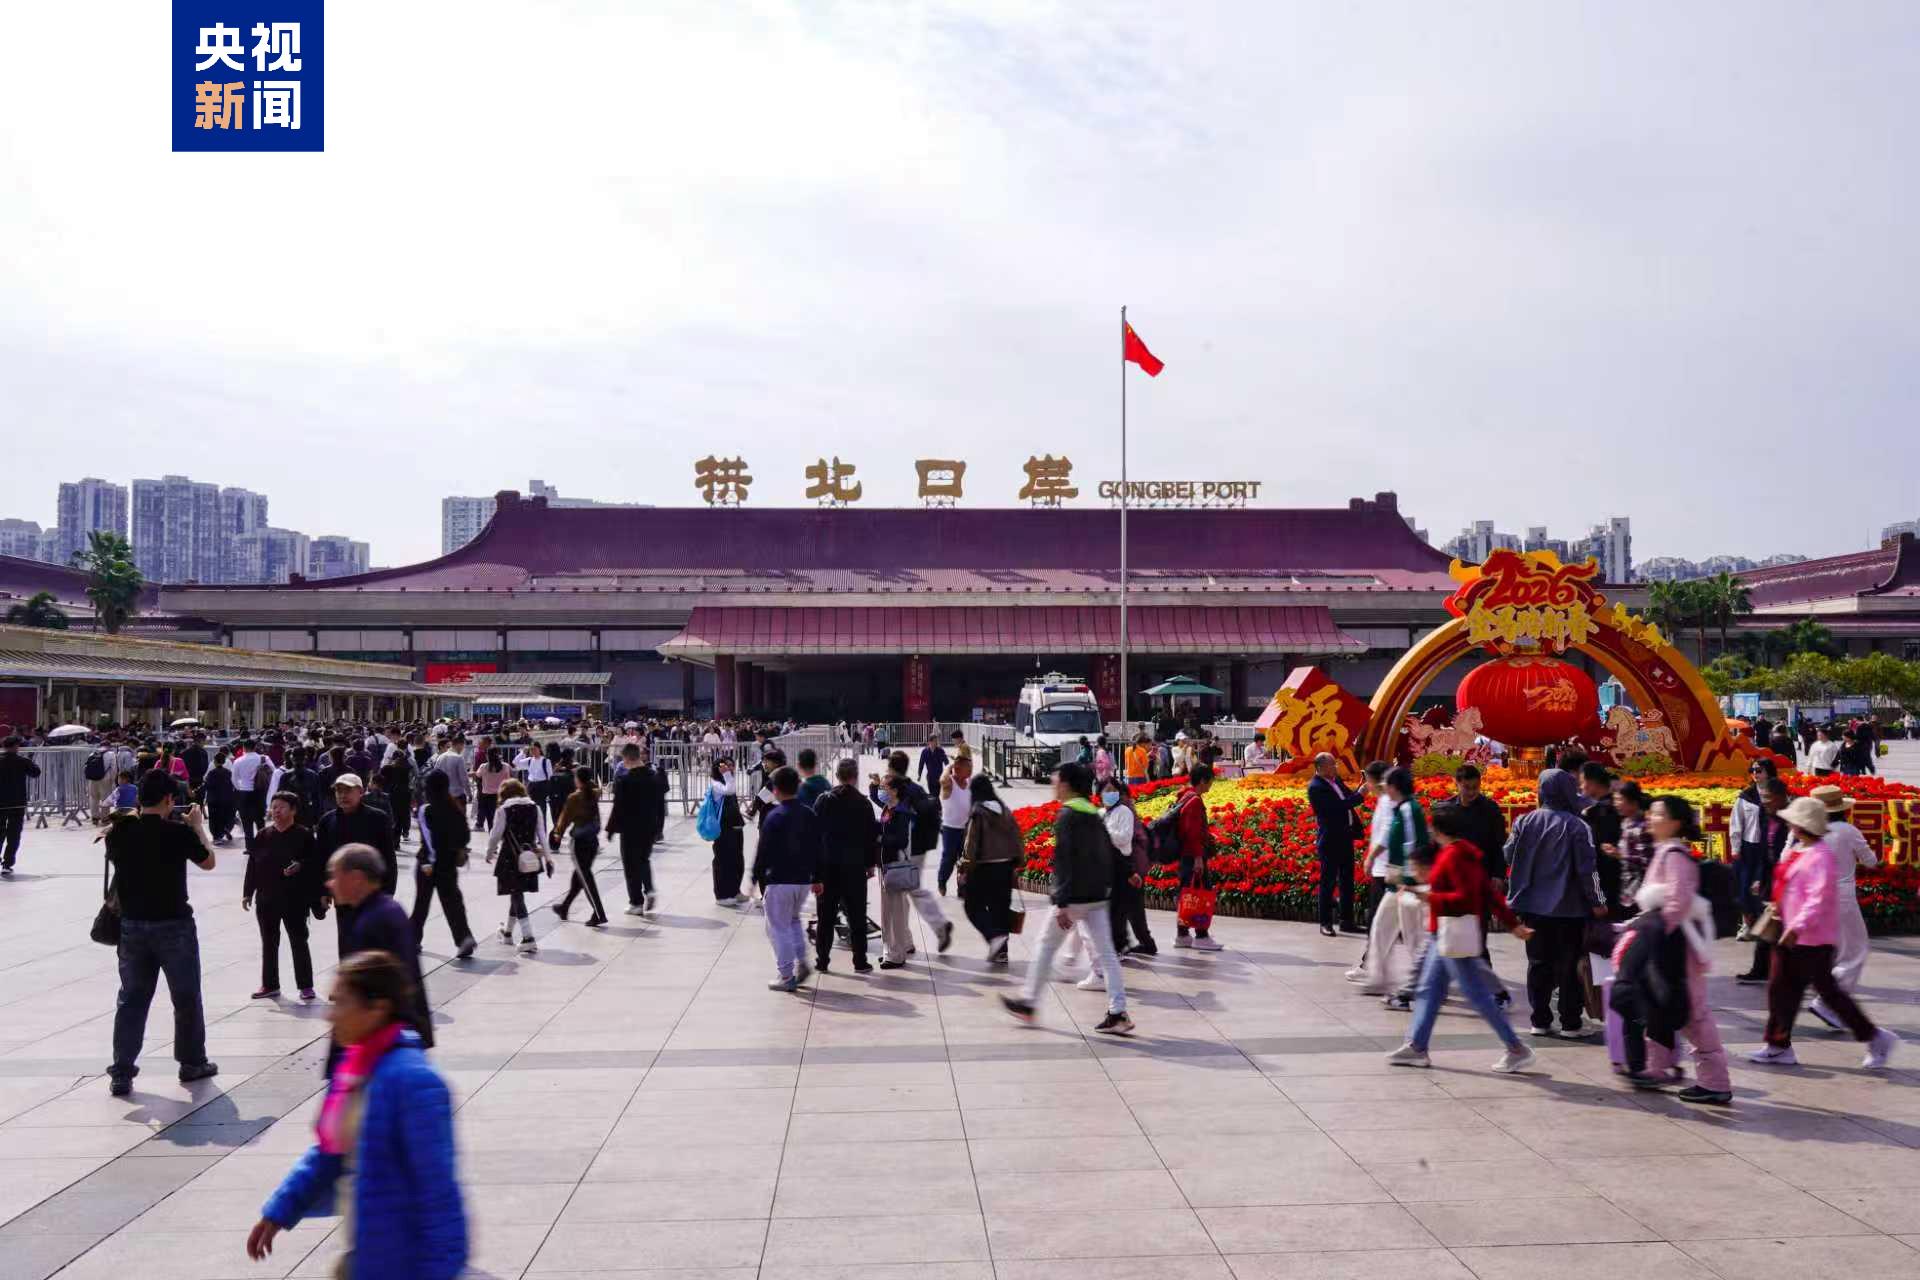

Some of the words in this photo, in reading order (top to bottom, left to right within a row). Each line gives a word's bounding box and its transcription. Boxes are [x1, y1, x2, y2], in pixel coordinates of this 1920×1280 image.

[695, 454, 1079, 506] 拱北口岸
[1098, 481, 1194, 499] GONGBEI
[1202, 481, 1261, 499] PORT
[1480, 549, 1598, 609] 2026
